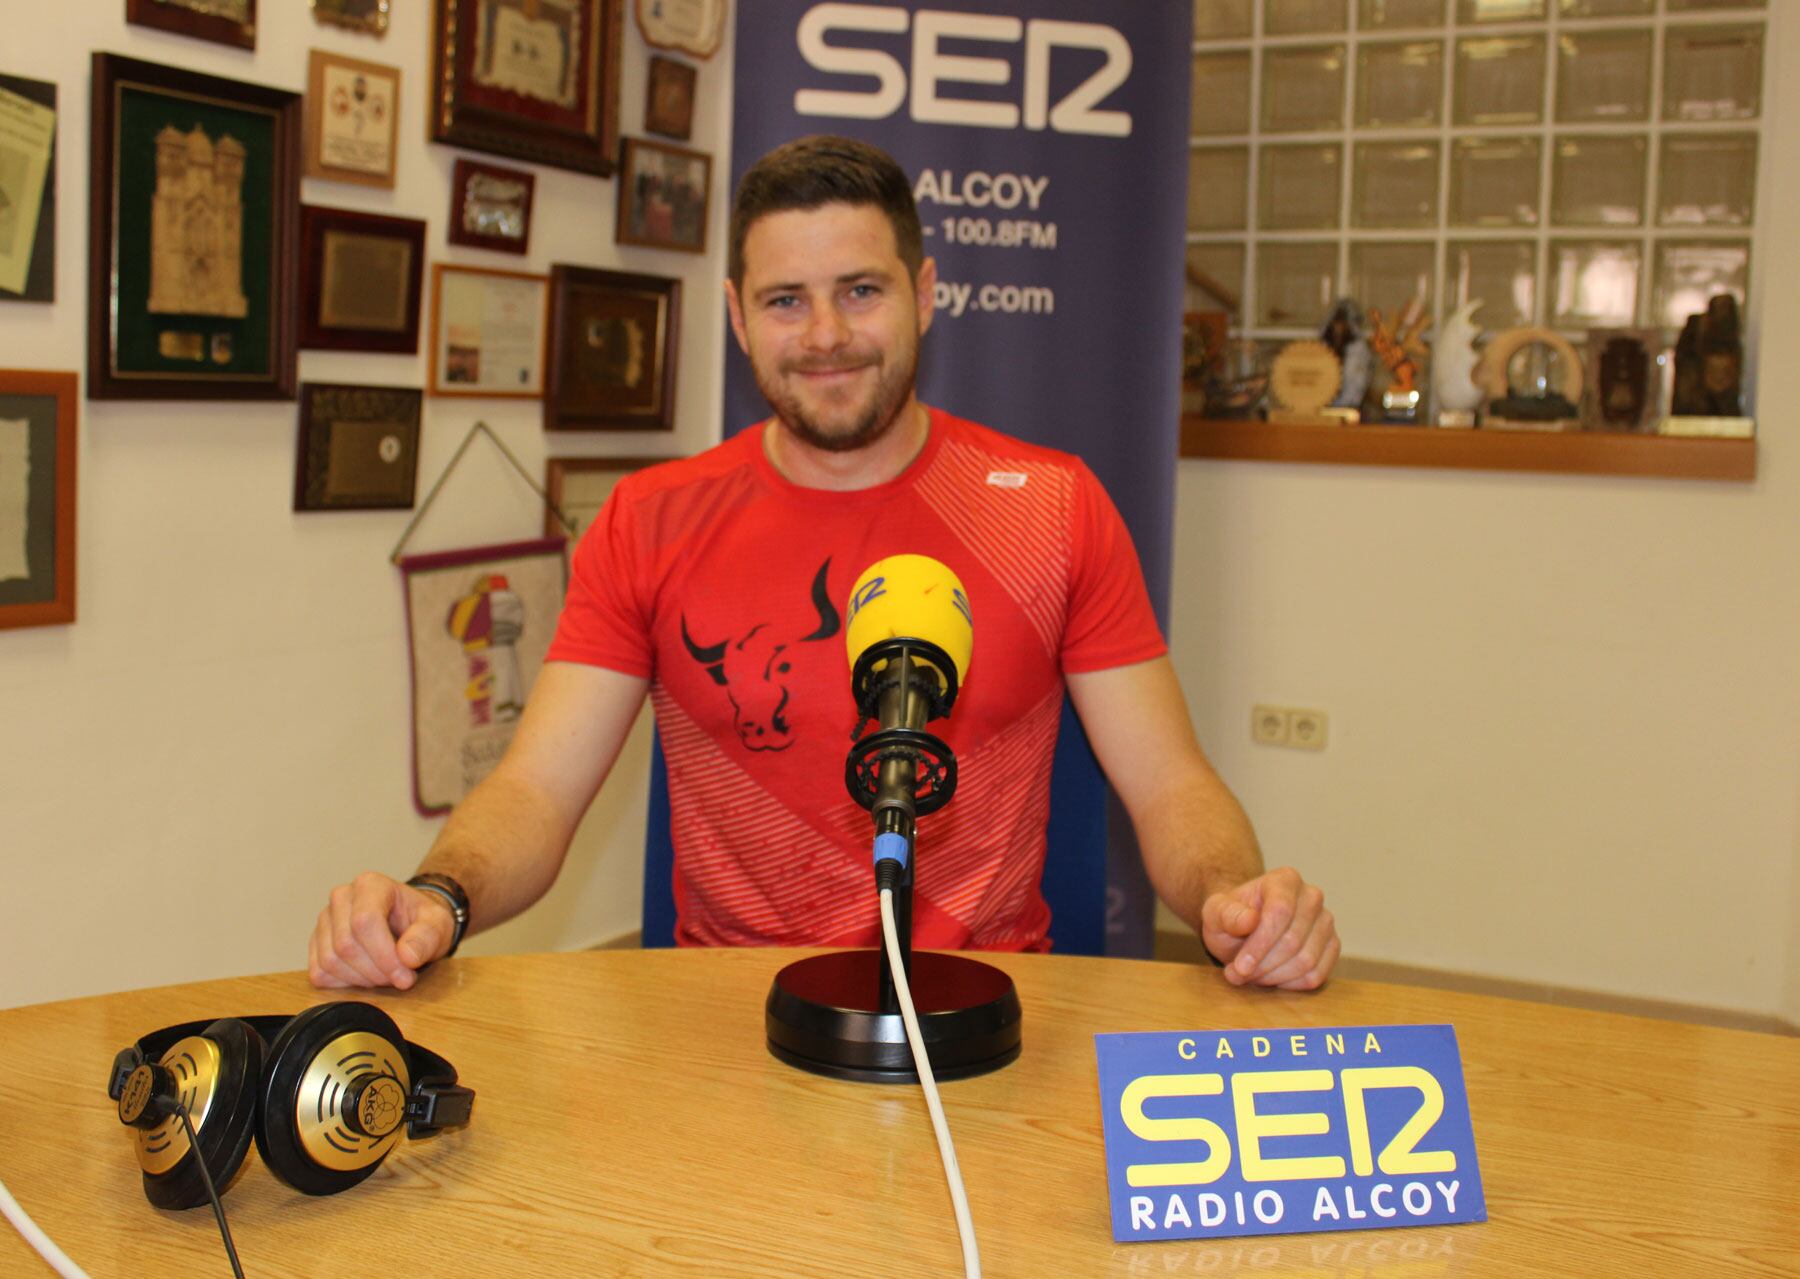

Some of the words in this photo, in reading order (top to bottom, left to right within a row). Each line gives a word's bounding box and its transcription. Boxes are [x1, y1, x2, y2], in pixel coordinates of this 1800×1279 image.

[794, 2, 1133, 137] SER
[913, 169, 1049, 210] ALCOY
[1178, 1032, 1382, 1060] CADENA
[1120, 1066, 1457, 1187] SER
[1130, 1189, 1285, 1231] RADIO
[1312, 1180, 1460, 1221] ALCOY
